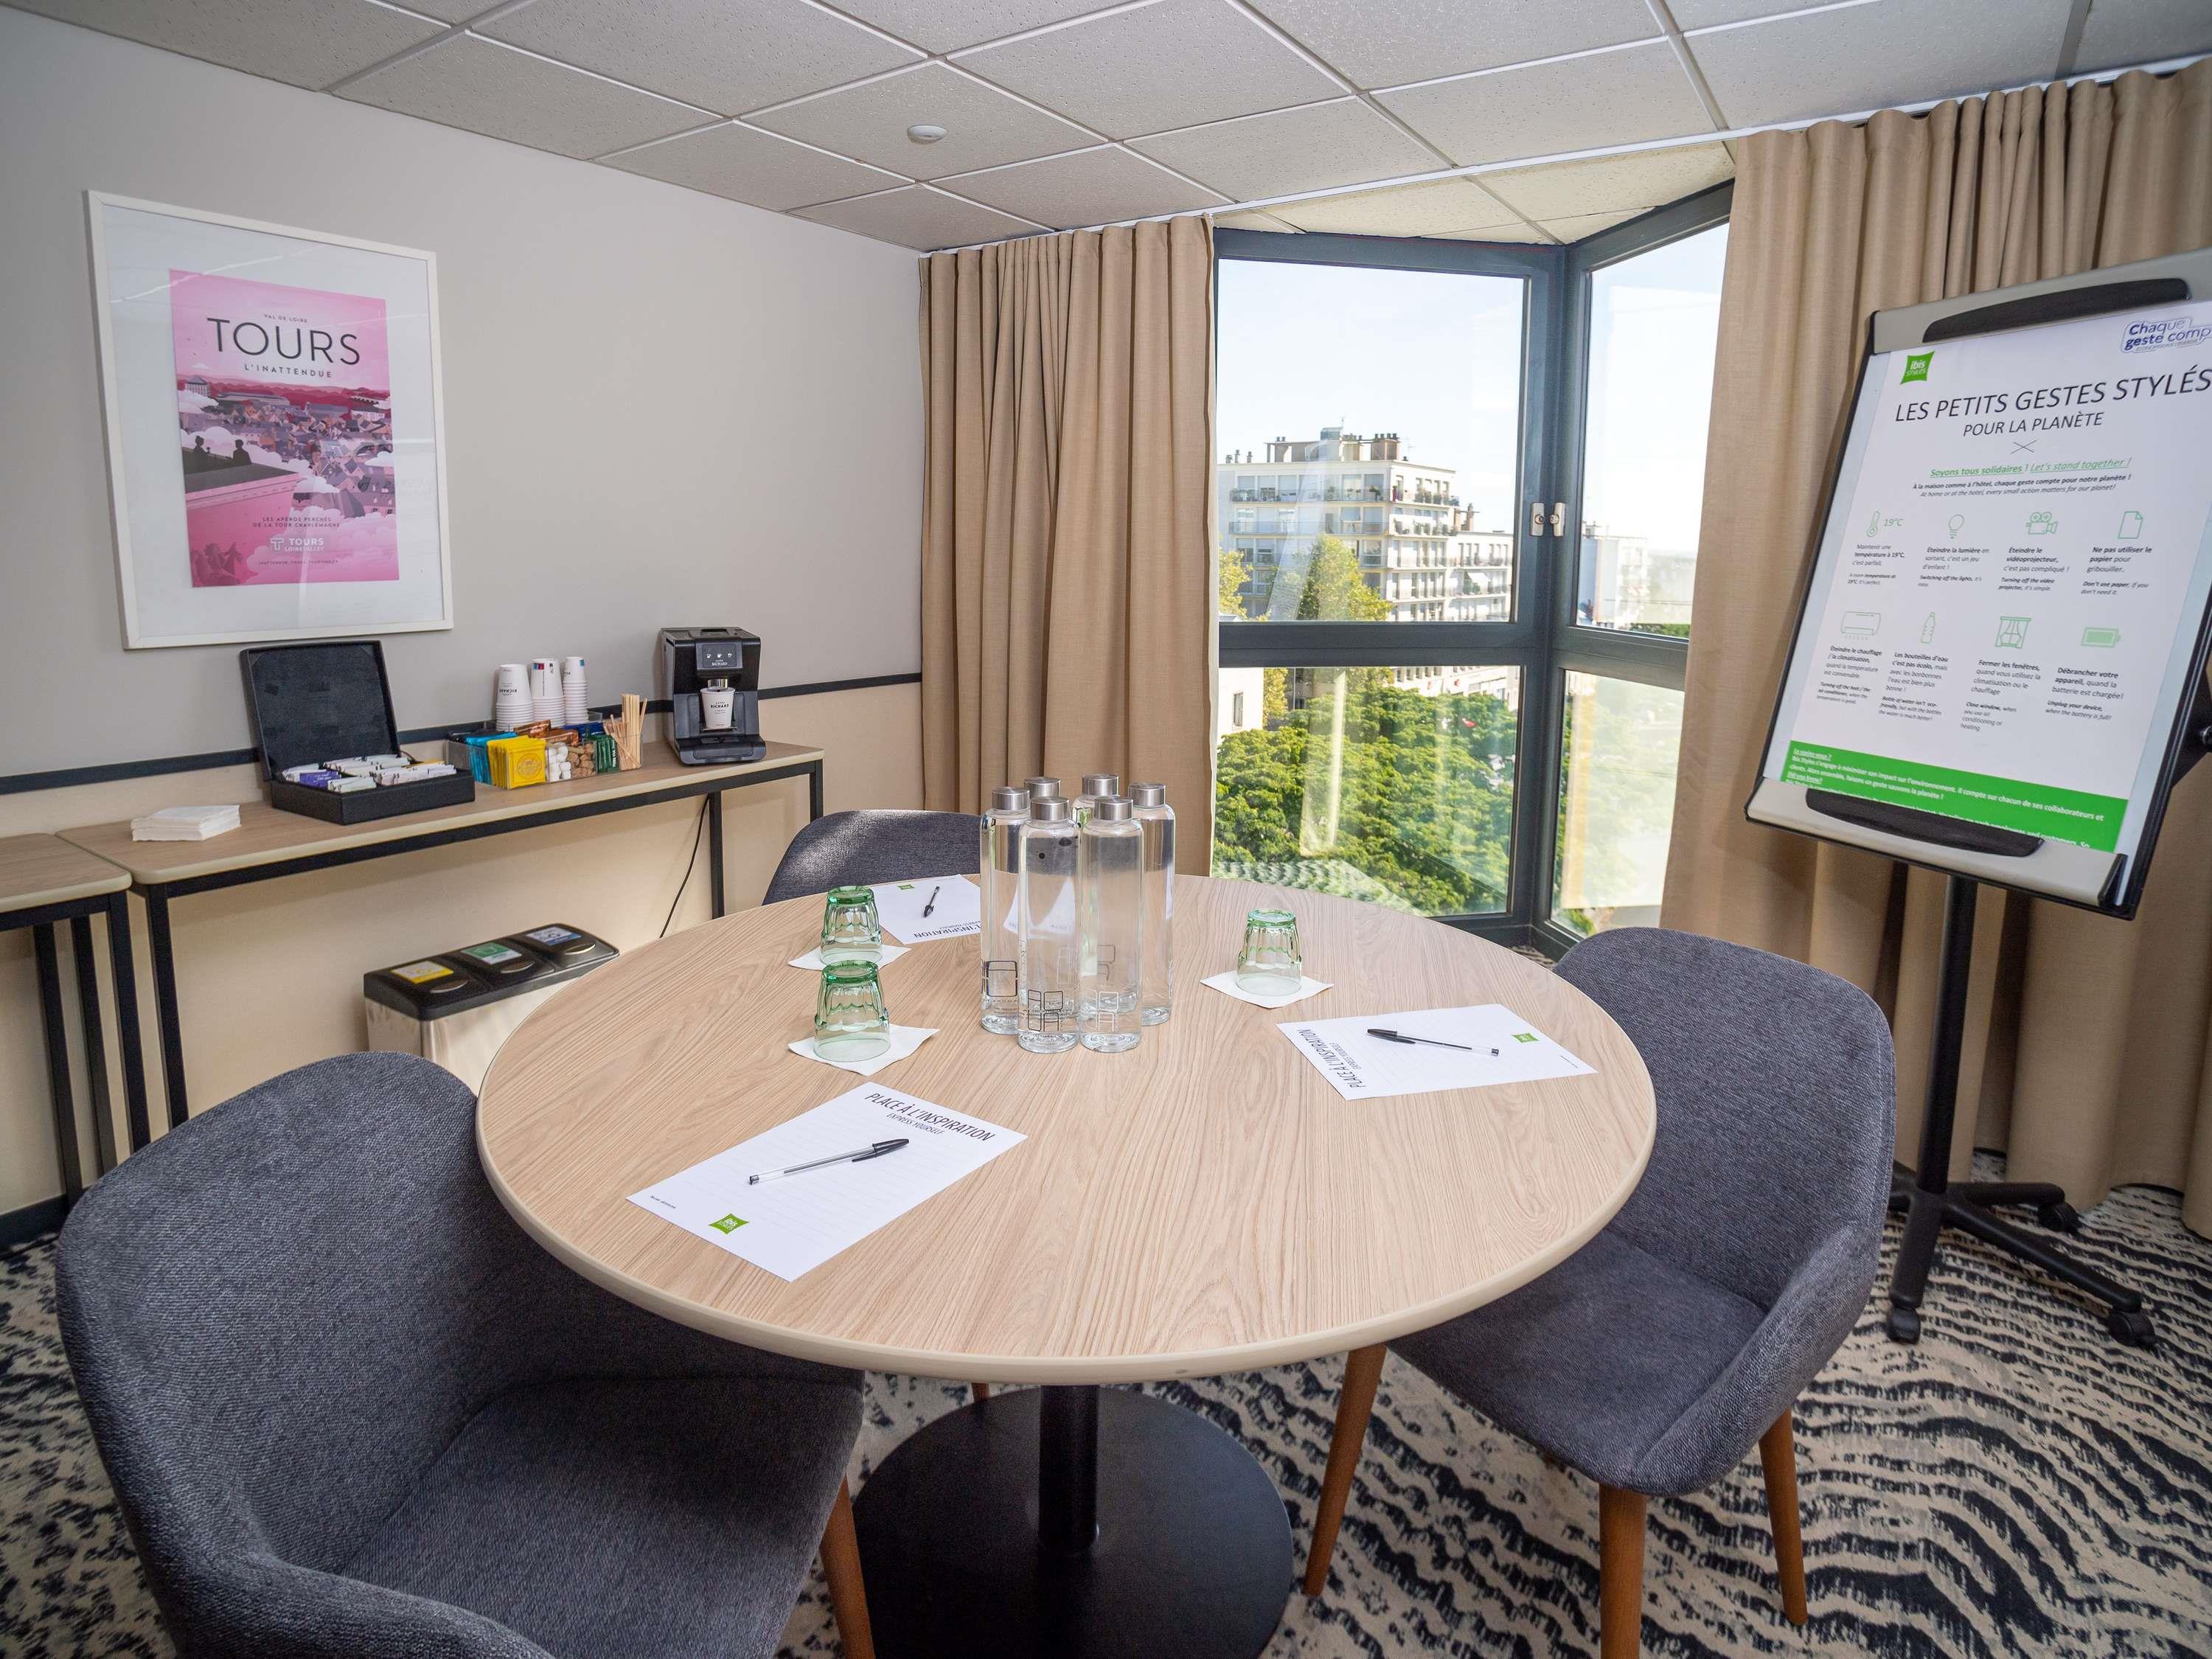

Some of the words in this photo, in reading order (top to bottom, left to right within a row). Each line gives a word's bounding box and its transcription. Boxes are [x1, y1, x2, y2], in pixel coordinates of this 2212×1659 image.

[2129, 320, 2185, 335] Chaque
[207, 318, 360, 365] TOURS
[2124, 335, 2164, 350] geste
[245, 364, 332, 378] L'INATTENDUE
[1910, 360, 1925, 369] ibis
[1895, 402, 1930, 422] LES
[1935, 394, 2008, 418] PETITS
[2015, 382, 2107, 410] GESTES
[2112, 364, 2212, 400] STYLÉS
[1963, 421, 2005, 437] POUR
[2008, 420, 2027, 433] LA
[2032, 411, 2104, 431] PLANÈTE
[1930, 469, 1959, 477] Soyons
[1981, 465, 2023, 474] solidaires
[2031, 463, 2051, 472] Let's
[2053, 461, 2081, 470] stand
[2081, 459, 2125, 470] together
[2065, 484, 2077, 493] for
[1884, 518, 1903, 526] 19°C
[288, 538, 324, 546] TOURS
[1904, 653, 1931, 661] bouteilles
[2057, 667, 2098, 677] Débrancher
[1973, 678, 2011, 686] climatisation
[1971, 686, 2000, 695] chauffage
[2052, 686, 2079, 695] batterie
[1998, 794, 2022, 805] chacun
[2022, 799, 2032, 807] de
[2044, 804, 2096, 819] collaborateurs
[914, 924, 981, 938] L'INSPIRATION
[1297, 1029, 1344, 1066] L'INSPIRATION
[1337, 1071, 1366, 1088] PLACE
[865, 1093, 905, 1110] PLACE
[897, 1103, 916, 1114] À
[908, 1108, 995, 1141] L'INSPIRATION
[886, 1112, 916, 1125] EXPRESS
[913, 1121, 946, 1135] YOURSELF
